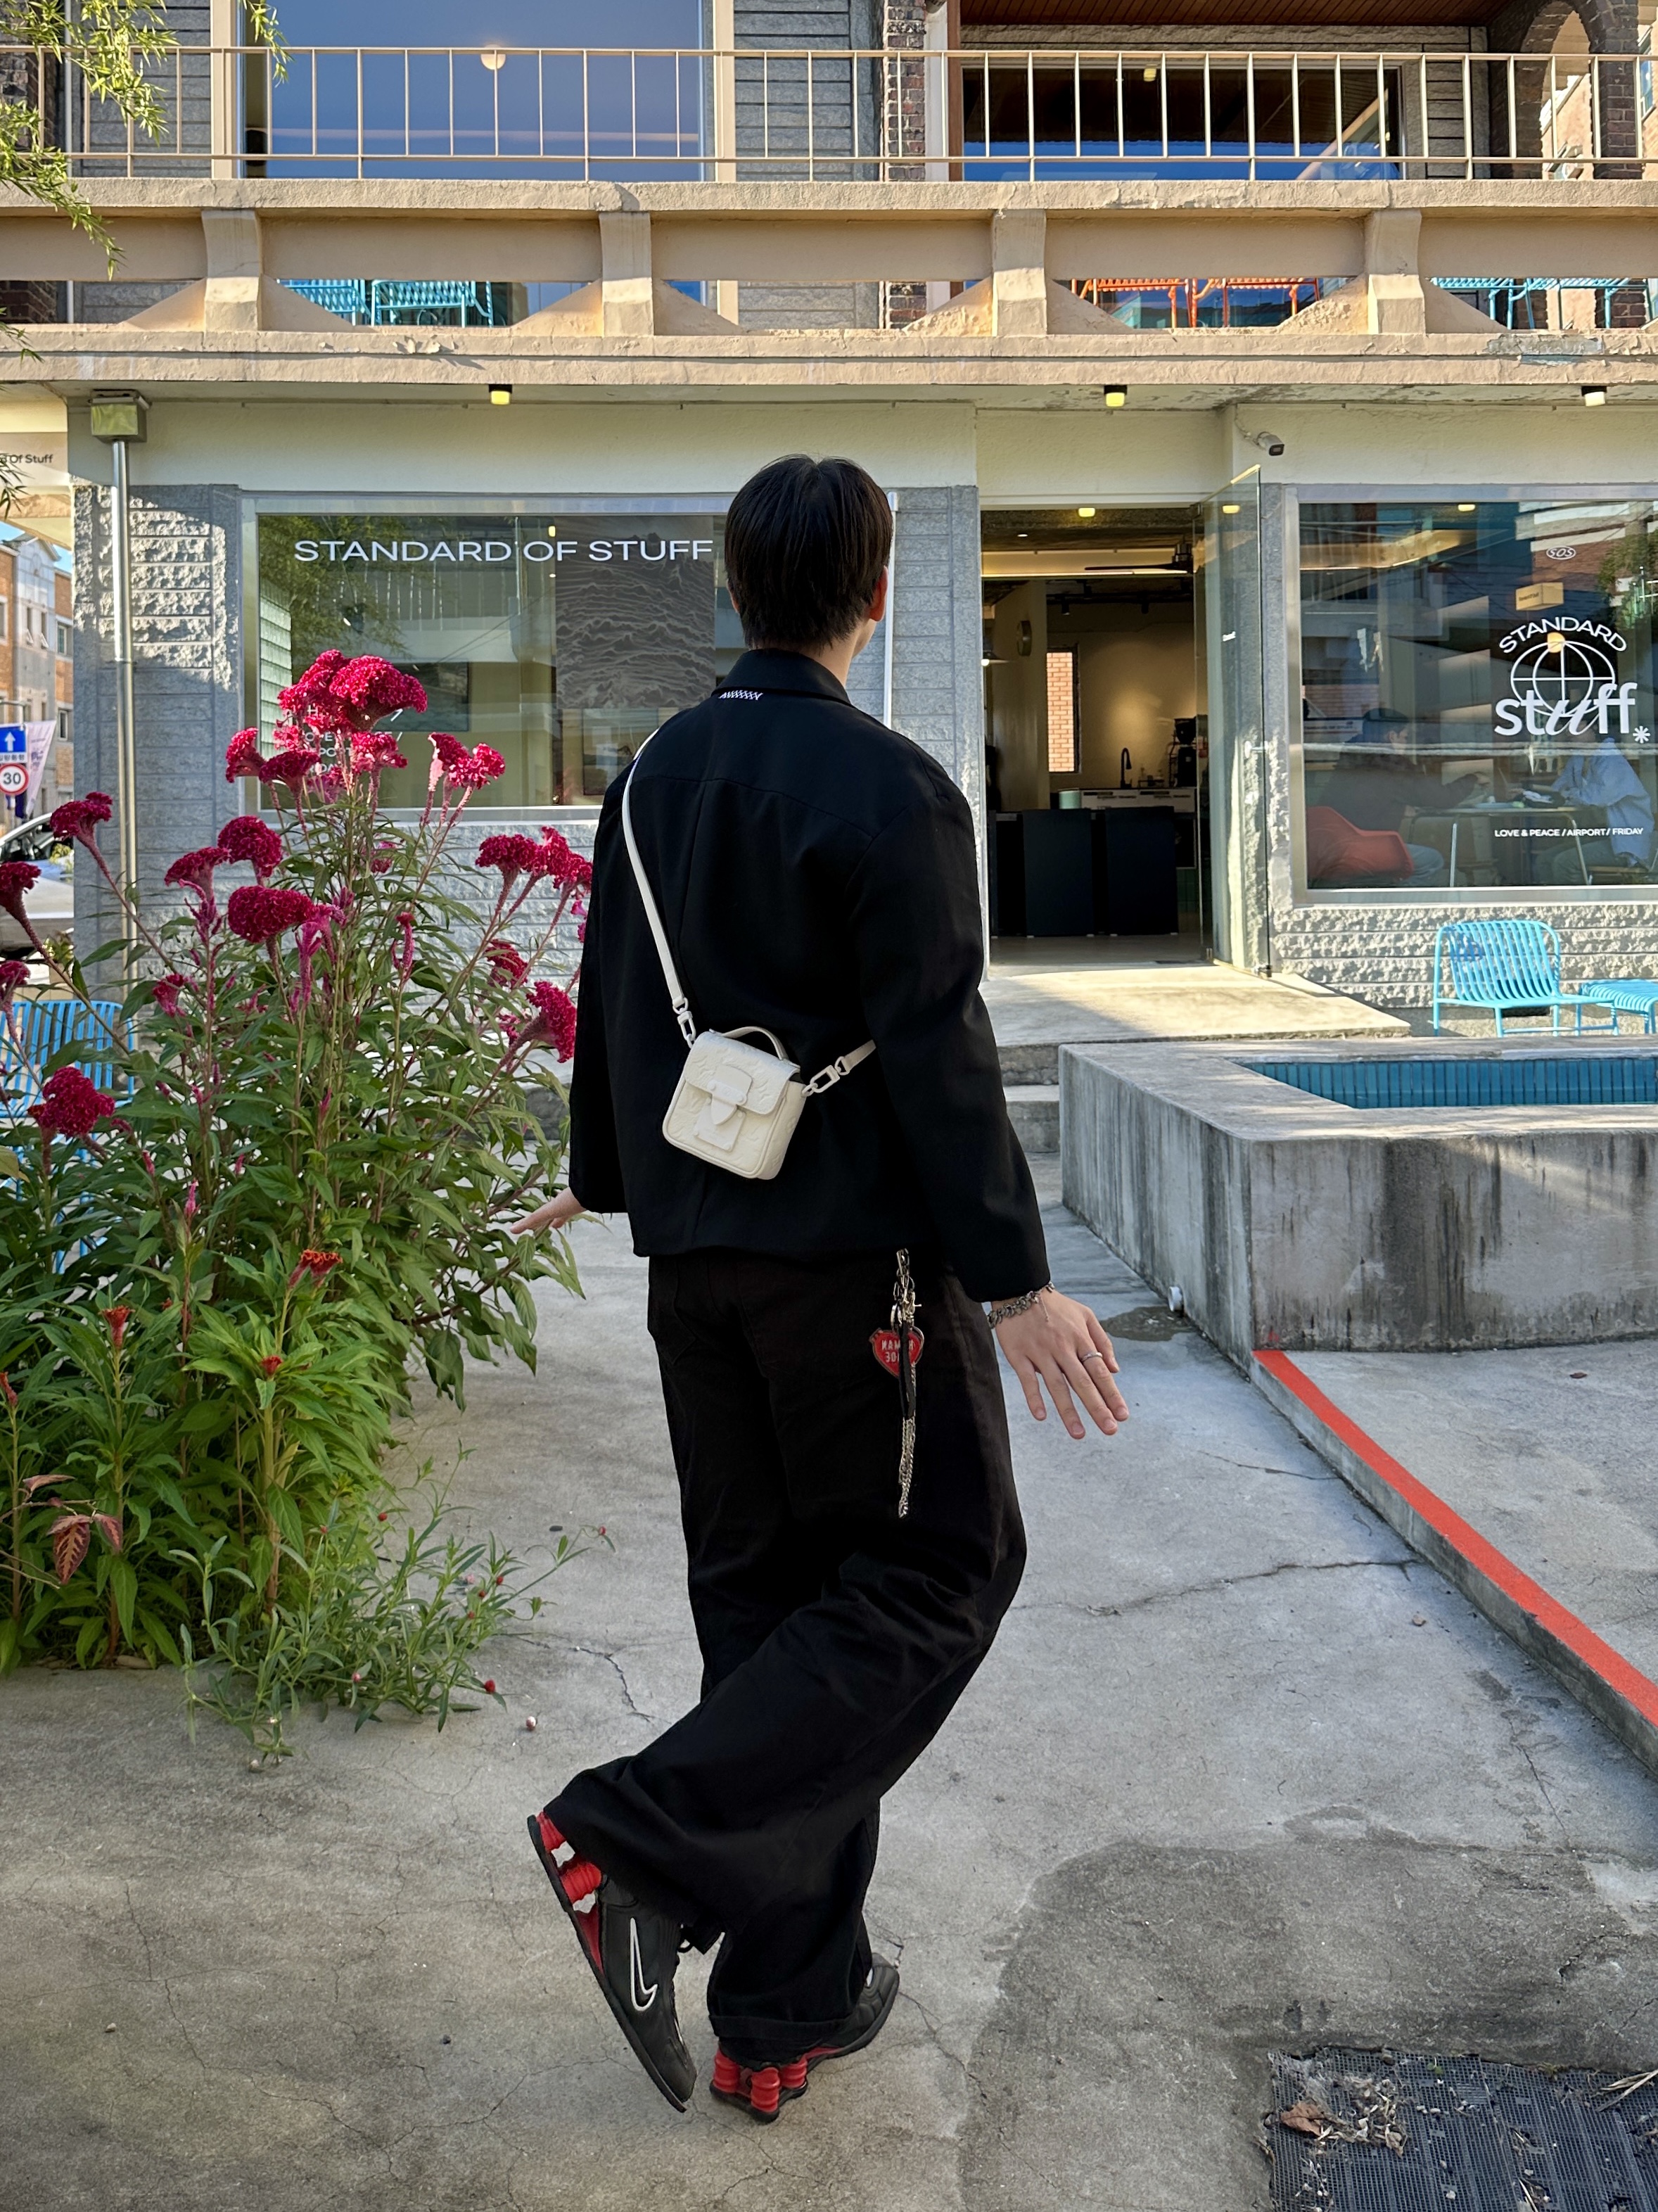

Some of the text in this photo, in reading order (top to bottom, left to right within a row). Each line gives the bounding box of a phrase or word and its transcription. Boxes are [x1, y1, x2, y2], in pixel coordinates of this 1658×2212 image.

[10, 454, 23, 464] Of
[25, 454, 53, 464] Stuff
[294, 540, 713, 561] STANDARD OF STUFF
[1549, 548, 1574, 558] SOS
[1499, 616, 1627, 653] STANDARD
[1494, 682, 1638, 736] stuff
[4, 772, 22, 784] 30
